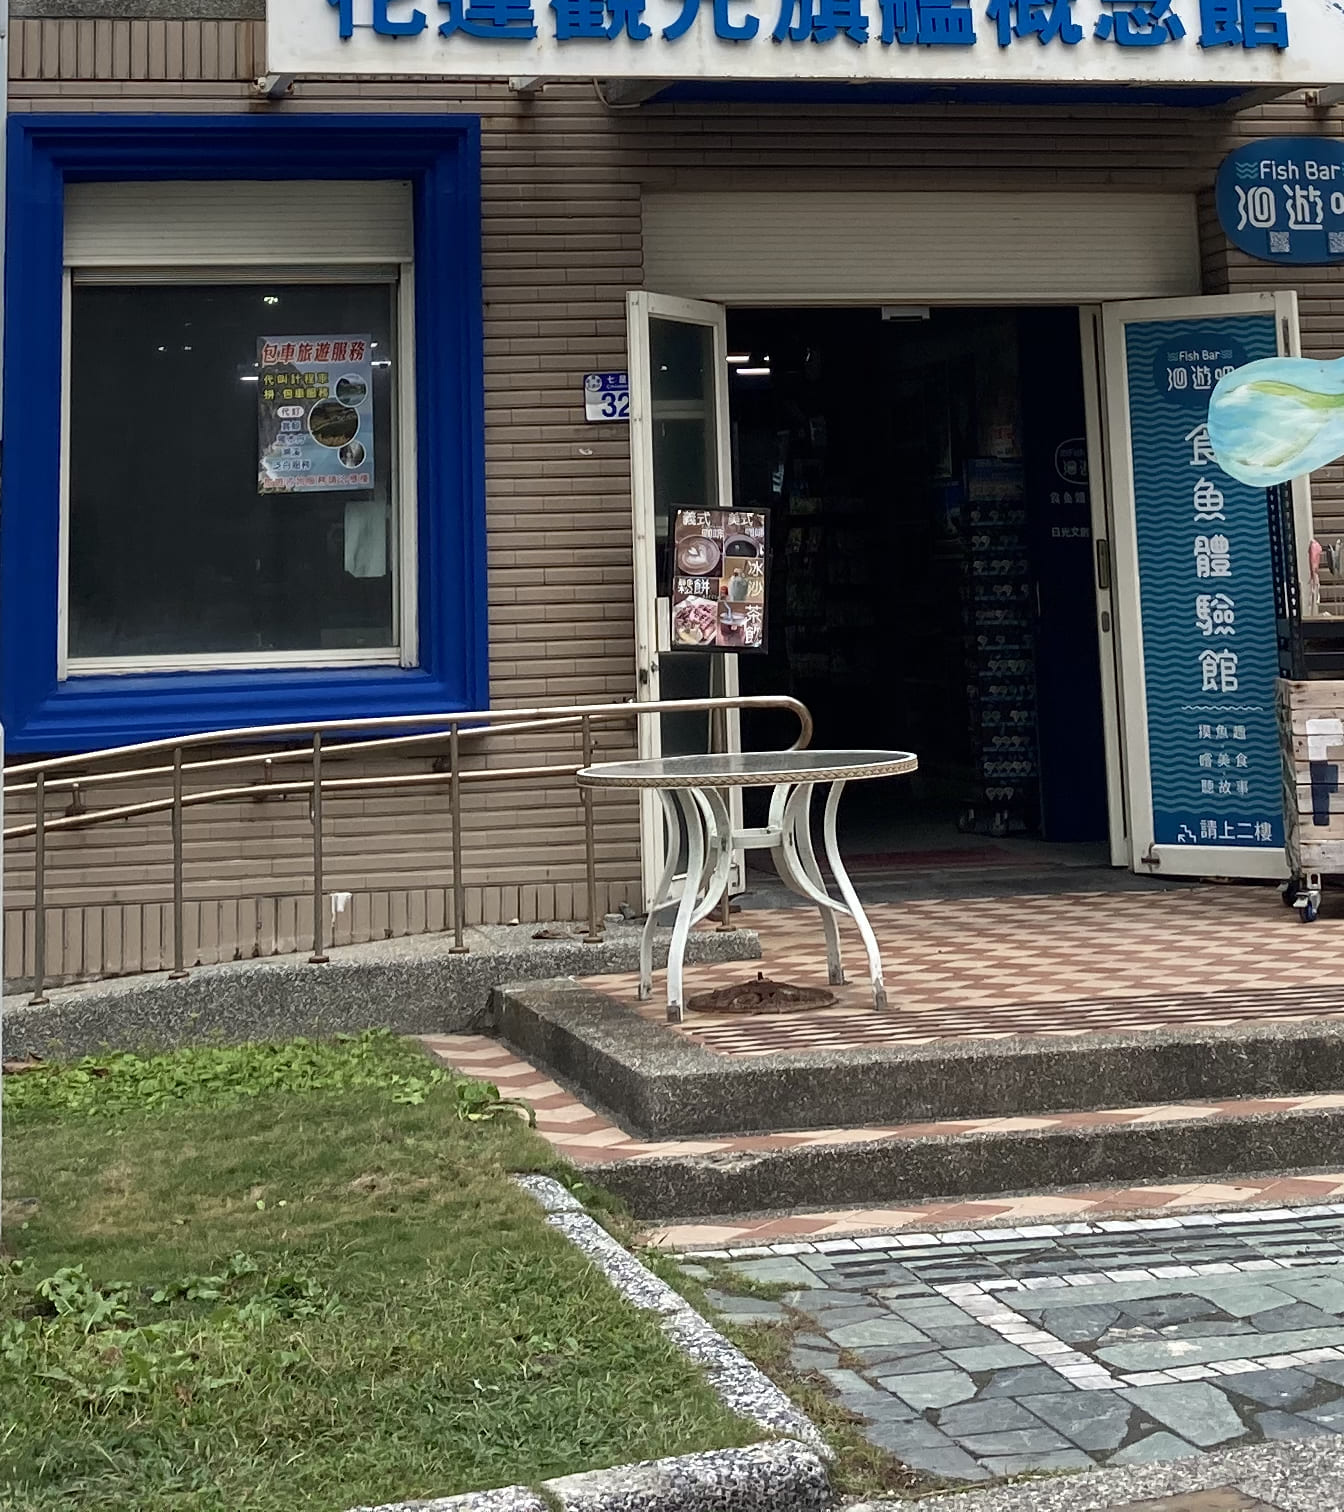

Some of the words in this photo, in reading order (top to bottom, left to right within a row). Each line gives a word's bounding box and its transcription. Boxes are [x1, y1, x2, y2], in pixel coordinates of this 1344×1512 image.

[1260, 160, 1299, 180] Fish
[1305, 161, 1341, 180] Bar
[262, 341, 366, 365] 包車旅遊服務
[1179, 350, 1200, 362] Fish
[1202, 350, 1221, 361] Bar
[1199, 819, 1273, 842] 請上二樓
